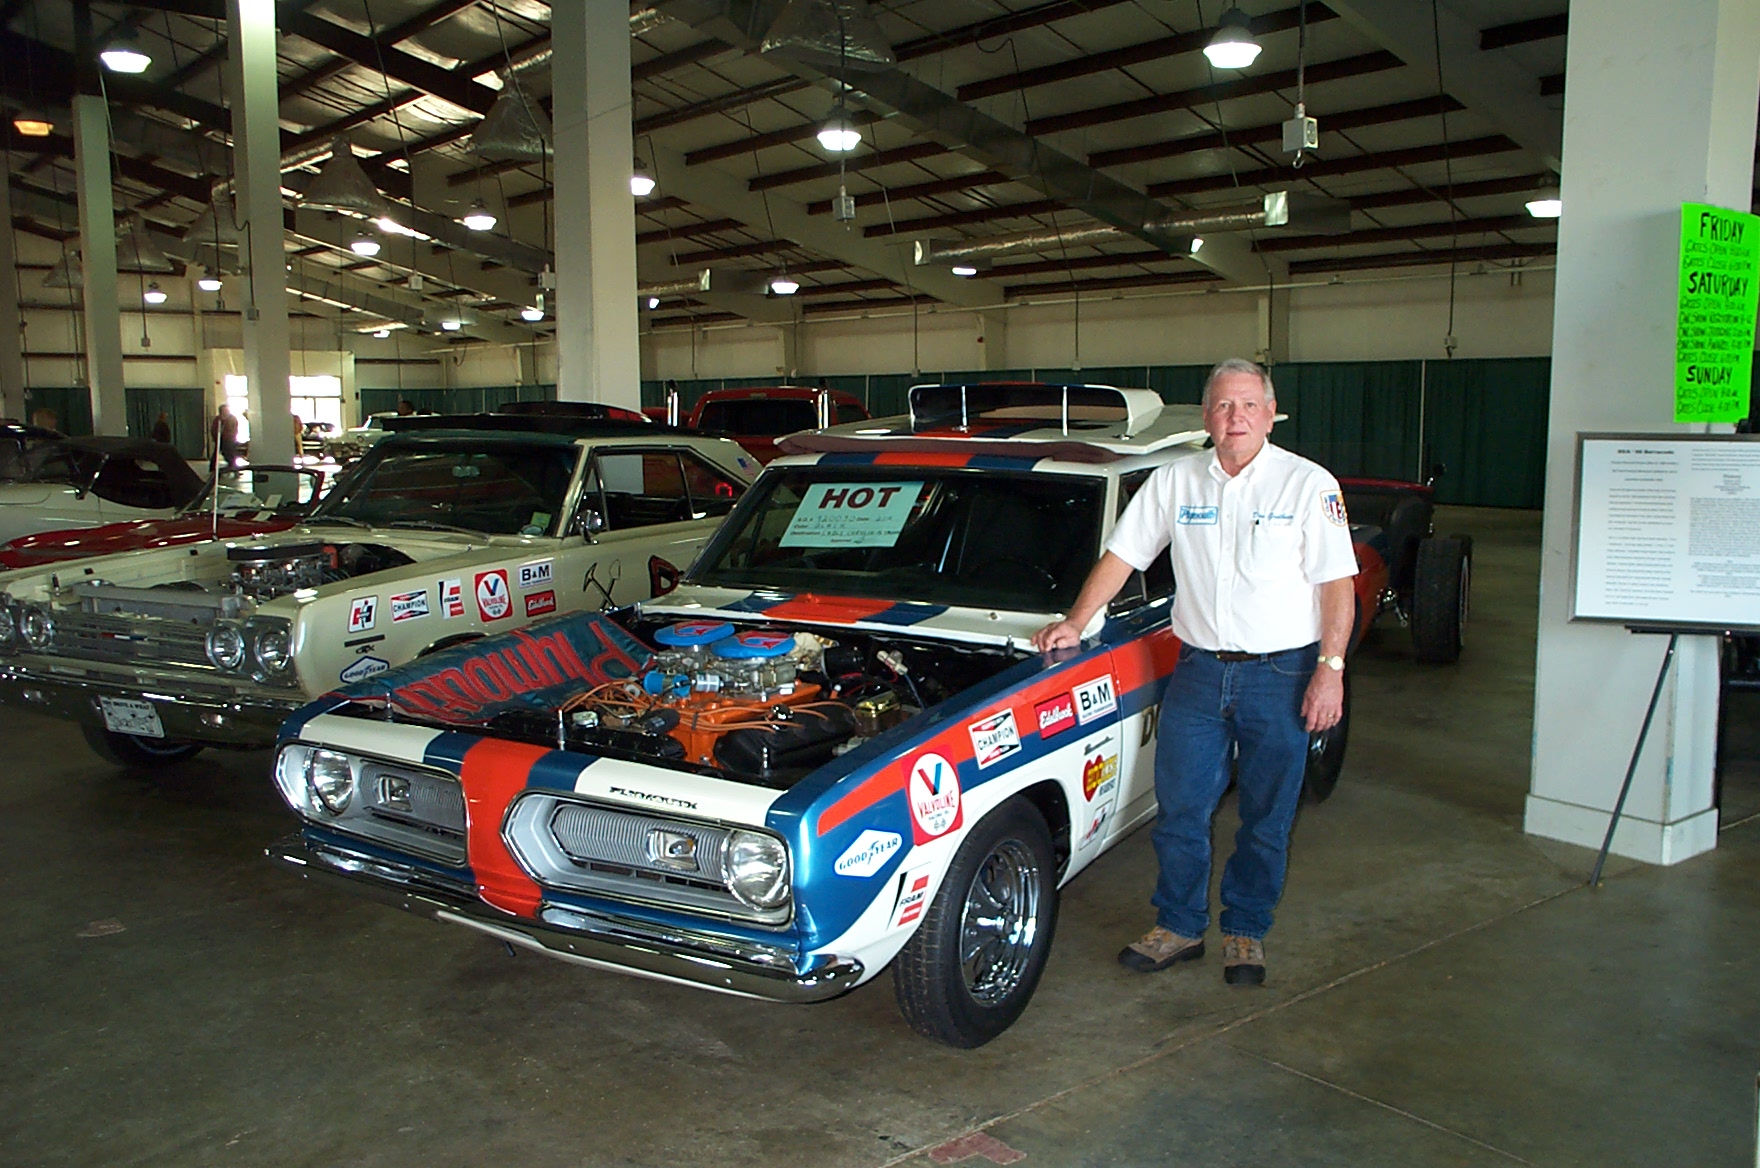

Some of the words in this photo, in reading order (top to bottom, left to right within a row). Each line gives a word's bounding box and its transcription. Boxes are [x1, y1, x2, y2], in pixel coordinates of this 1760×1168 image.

[1700, 212, 1745, 244] FRIDAY
[1688, 271, 1749, 298] SATURDAY
[1686, 365, 1733, 386] SUNDAY
[818, 486, 902, 509] HOT
[522, 565, 550, 581] B&M
[394, 600, 425, 612] CHAMPION
[393, 621, 640, 719] Plymouth
[1079, 682, 1111, 711] B&M
[977, 727, 1015, 751] CHAMPION
[609, 786, 698, 809] PLYMOUTH
[917, 790, 955, 818] VALVOLINE
[900, 891, 925, 906] FRAM
